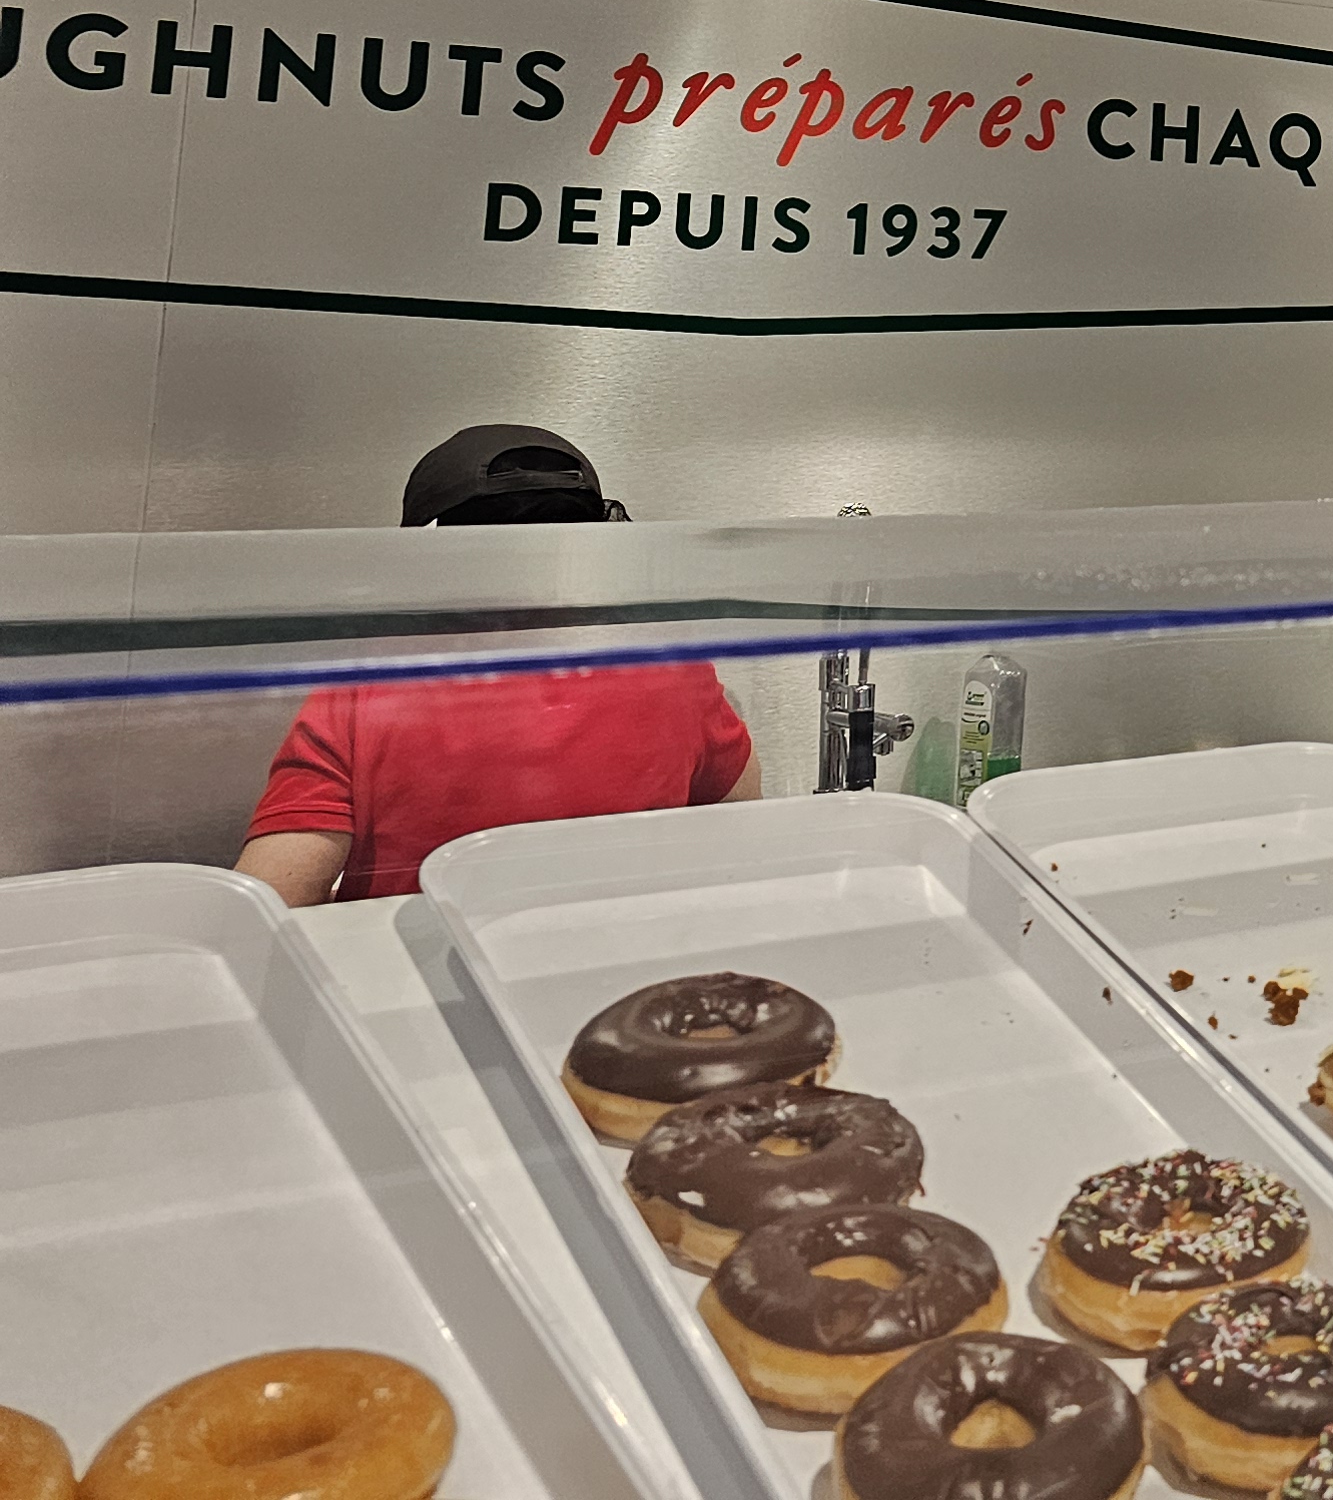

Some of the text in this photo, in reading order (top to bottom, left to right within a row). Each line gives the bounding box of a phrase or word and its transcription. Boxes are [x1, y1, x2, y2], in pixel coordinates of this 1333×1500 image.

[589, 53, 1066, 167] préparés
[483, 182, 1008, 260] DEPUIS 1937
